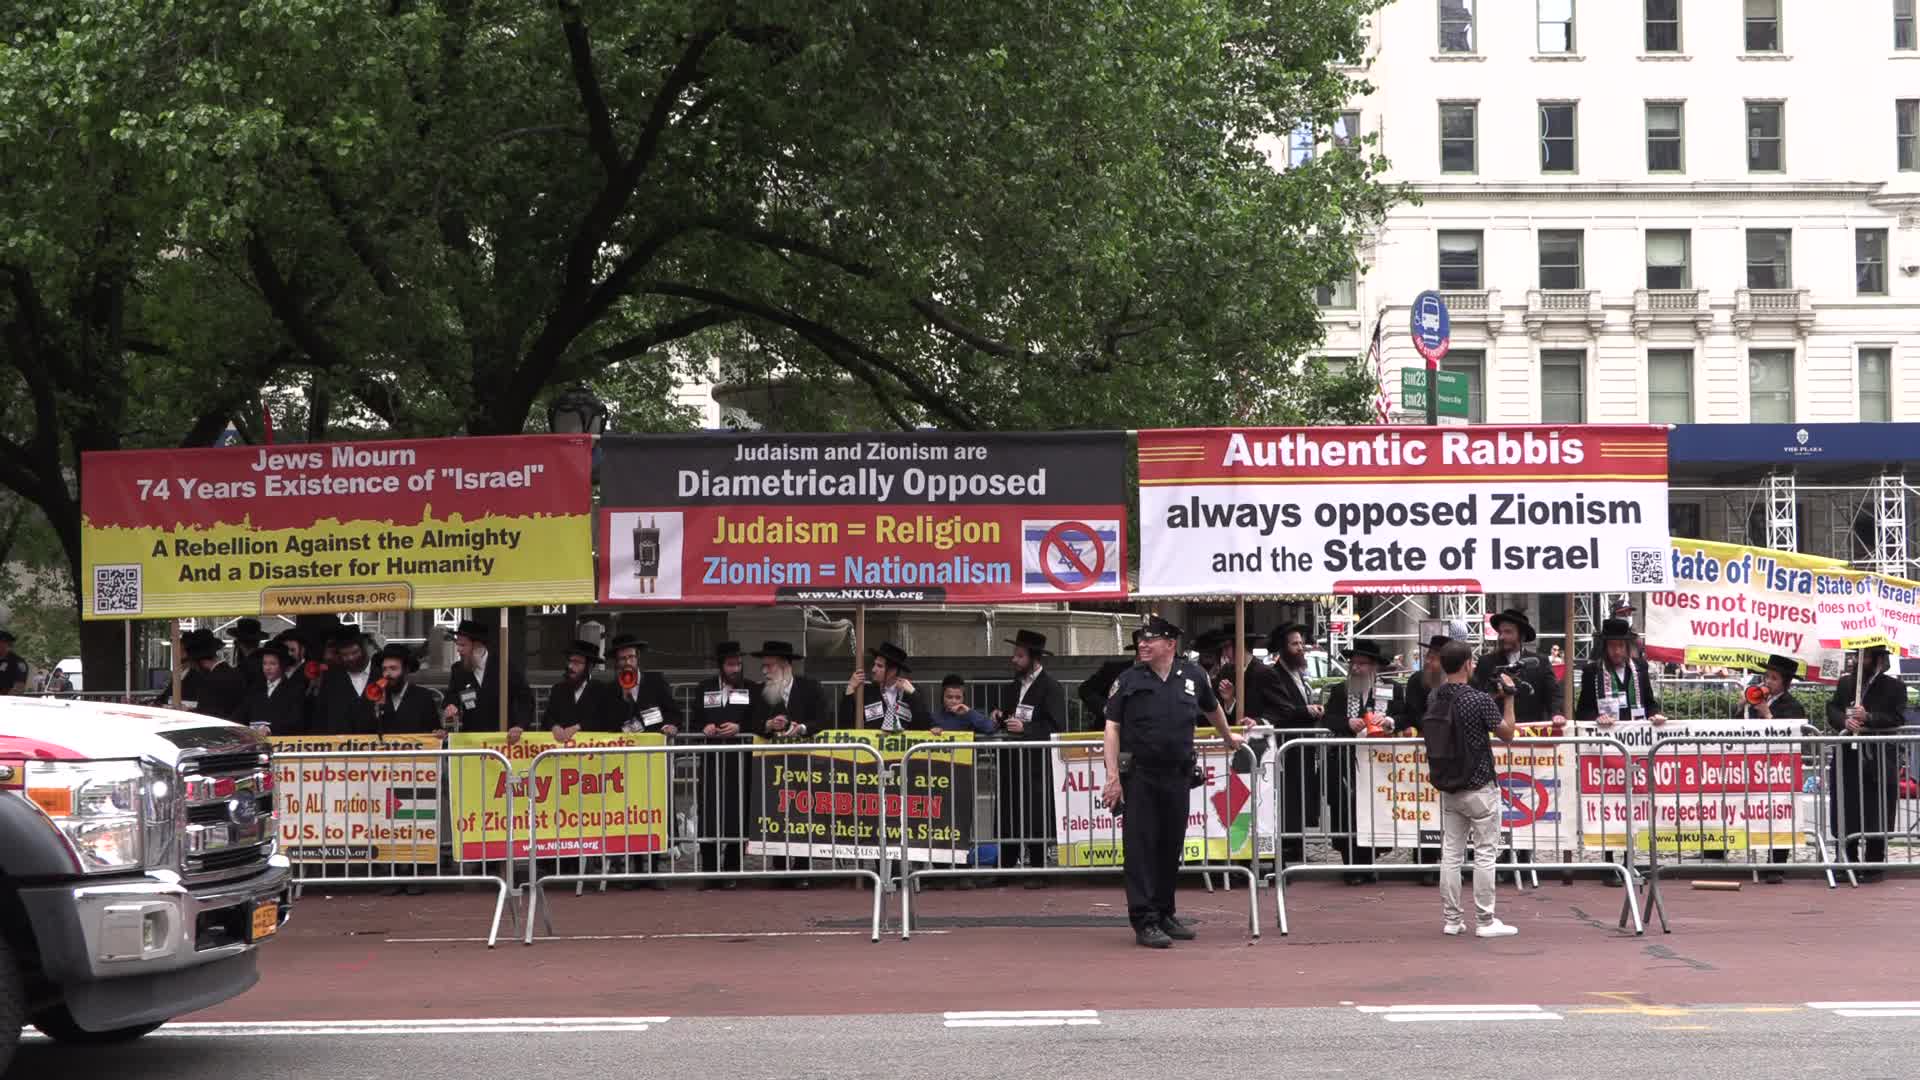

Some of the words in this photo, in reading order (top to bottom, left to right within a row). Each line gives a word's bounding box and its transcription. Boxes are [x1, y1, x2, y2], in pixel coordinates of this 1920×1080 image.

[251, 449, 326, 472] Jews
[331, 446, 416, 469] Mourn
[734, 443, 820, 463] Judaism
[824, 443, 862, 461] and
[867, 442, 949, 461] Zionism
[954, 446, 988, 460] are
[1222, 433, 1427, 467] Authentic
[1442, 432, 1585, 465] Rabbis
[137, 478, 171, 501] 74
[178, 476, 257, 500] Years
[265, 472, 400, 498] Existence
[407, 469, 436, 492] of
[441, 464, 545, 489] "Israel"
[678, 468, 896, 502] Diametrically
[903, 468, 1047, 502] Opposed
[1166, 496, 1302, 536] always
[1314, 495, 1478, 534] opposed
[1489, 493, 1642, 525] Zionism
[151, 540, 168, 558] A
[175, 536, 280, 557] Rebellion
[285, 534, 372, 556] Against
[377, 532, 415, 550] the
[421, 529, 521, 552] Almighty
[712, 516, 838, 544] Judaism
[847, 525, 865, 536] =
[875, 515, 1001, 548] Religion
[1212, 547, 1263, 572] and
[1270, 546, 1314, 572] the
[1324, 539, 1427, 572] State
[1440, 537, 1476, 570] of
[1491, 537, 1599, 570] Israel
[178, 562, 222, 583] And
[228, 567, 242, 581] a
[248, 559, 342, 580] Disaster
[348, 558, 381, 577] for
[387, 555, 495, 578] Humanity
[703, 557, 811, 584] Zionism
[819, 565, 836, 577] =
[844, 556, 1012, 585] Nationalism
[1672, 549, 1719, 582] tate
[1727, 555, 1752, 584] of
[1758, 557, 1812, 594] "Isra
[797, 588, 924, 600] www.NKUSA.org
[1352, 583, 1467, 593] www.nkusa.org
[1817, 576, 1853, 595] State
[1856, 576, 1872, 594] of
[277, 590, 396, 608] www.nkusa.ORG
[1652, 592, 1700, 609] does
[1706, 593, 1746, 612] not
[1752, 600, 1816, 625] repres
[1818, 601, 1845, 613] does
[1848, 600, 1872, 613] not
[1880, 608, 1920, 624] resent
[1841, 616, 1877, 630] world
[1691, 618, 1749, 639] world
[1753, 622, 1804, 652] Jewry
[272, 740, 333, 752] daism
[338, 739, 424, 752] dictates
[480, 740, 557, 760] Judaism
[564, 737, 636, 760] Rejects
[1585, 728, 1611, 746] The
[1615, 727, 1653, 746] world
[1656, 727, 1690, 746] must
[1694, 726, 1760, 751] recognize
[1765, 726, 1792, 744] that
[1369, 749, 1429, 763] Peacefu
[1495, 752, 1564, 766] ntlement
[303, 765, 437, 782] subservience
[494, 770, 552, 803] Any
[560, 766, 624, 796] Part
[773, 765, 822, 786] Jews
[829, 768, 849, 784] in
[915, 775, 950, 788] are
[1062, 771, 1101, 792] ALL
[1388, 768, 1405, 783] of
[1588, 761, 1625, 786] Israe
[1632, 764, 1647, 786] is
[1653, 761, 1681, 786] NOT
[1685, 766, 1695, 785] a
[1700, 761, 1749, 785] Jewish
[1754, 760, 1792, 785] State
[285, 793, 299, 814] To
[305, 793, 327, 813] ALL
[334, 792, 380, 813] nations
[778, 789, 943, 819] FORBIDDEN
[1392, 807, 1430, 821] State
[1587, 801, 1596, 821] It
[1600, 801, 1611, 821] s
[1615, 800, 1658, 822] toall
[1662, 799, 1717, 825] reected
[1740, 800, 1793, 820] Judaism
[457, 813, 475, 832] of
[481, 809, 548, 831] Zionist
[554, 805, 662, 829] Occupation
[758, 816, 779, 834] To
[784, 816, 826, 835] have
[918, 824, 961, 841] State
[1063, 815, 1124, 831] Palestina
[283, 824, 319, 840] U.S.
[325, 826, 344, 839] to
[352, 824, 436, 840] Palestine
[819, 847, 899, 859] www.NKUSAorg
